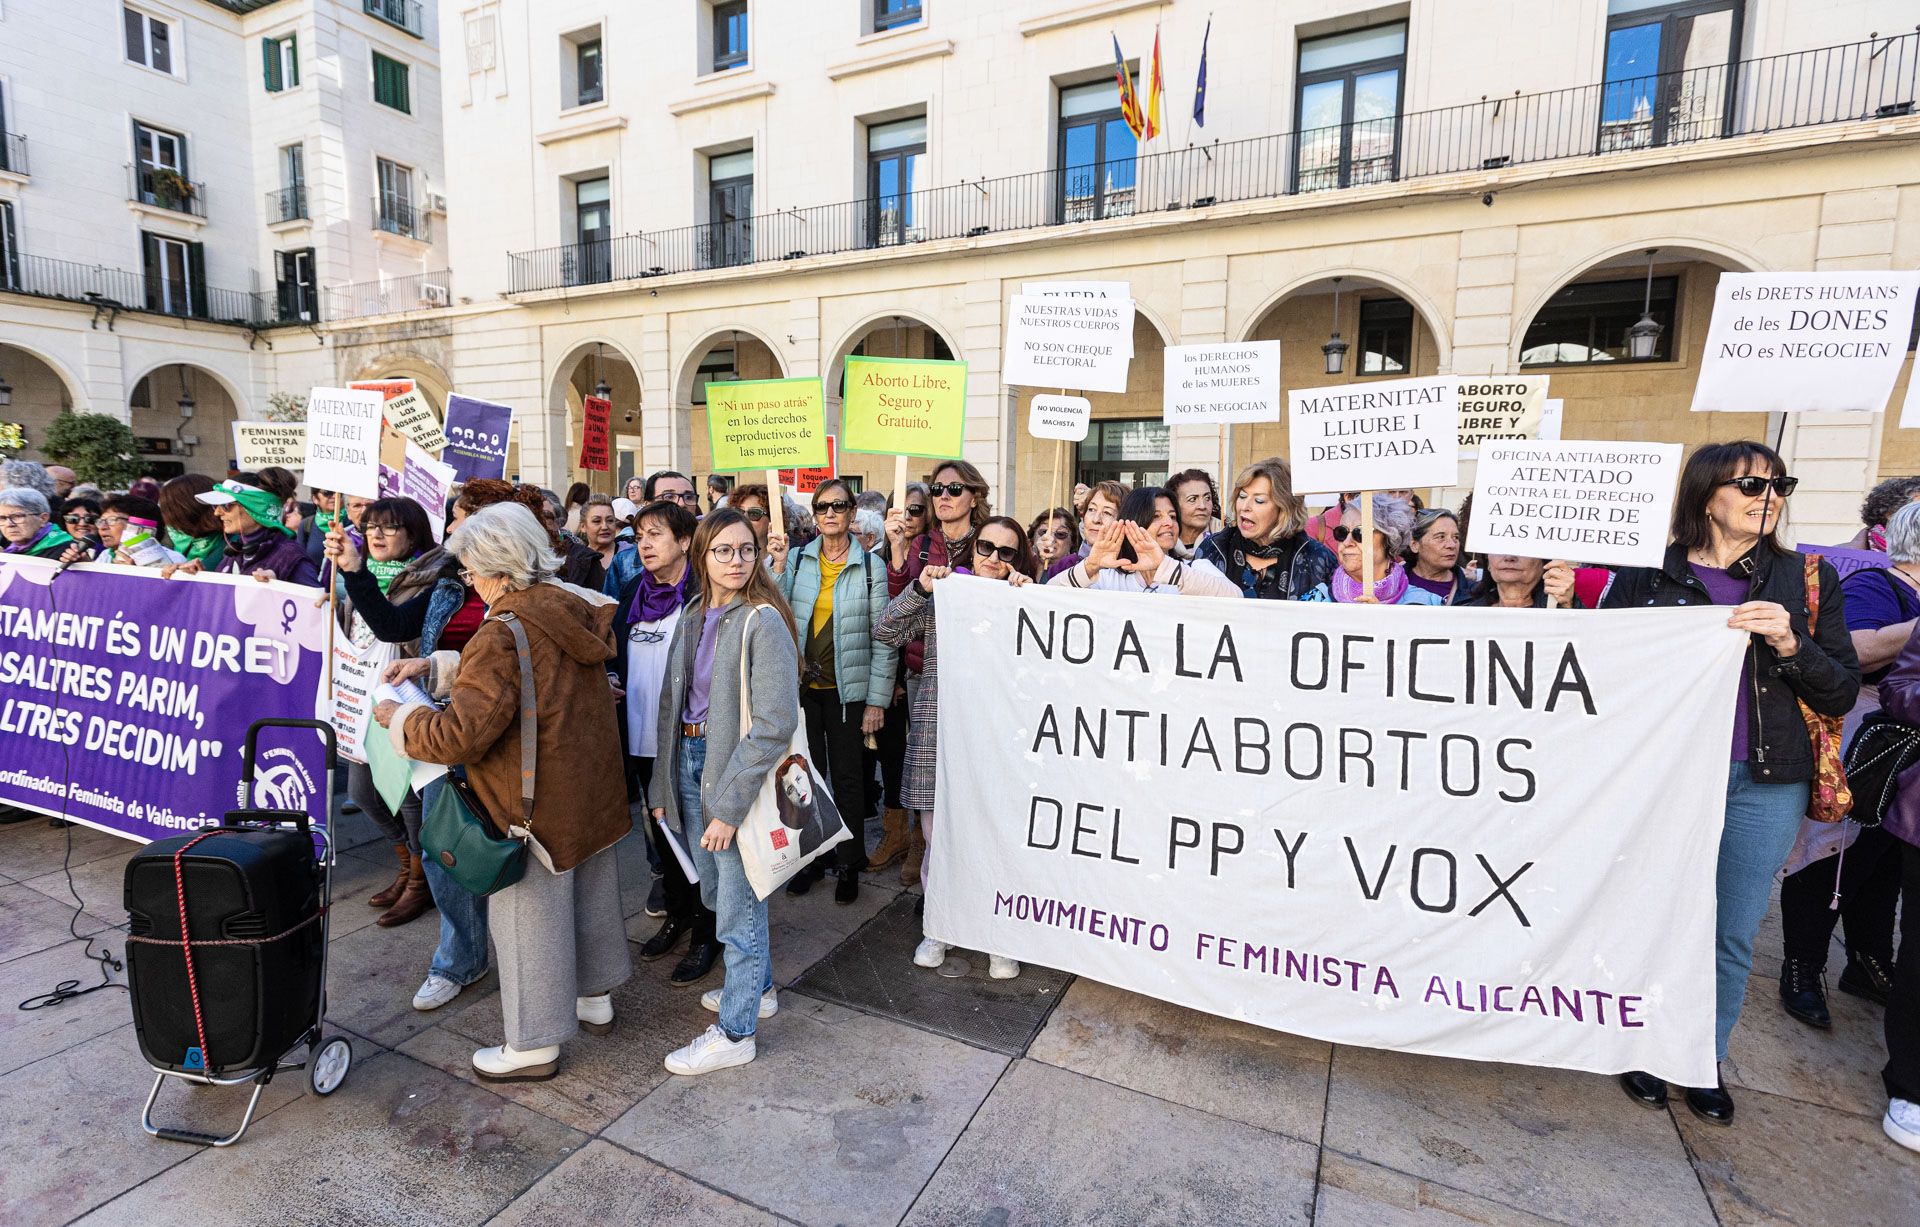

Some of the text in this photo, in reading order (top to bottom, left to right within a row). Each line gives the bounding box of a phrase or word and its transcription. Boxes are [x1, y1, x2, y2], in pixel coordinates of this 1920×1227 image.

[1731, 286, 1899, 300] els DRETS HUMANS
[1024, 304, 1118, 318] NUESTRAS VIDAS
[1020, 318, 1120, 331] NUESTROS CUERPOS
[1734, 310, 1888, 331] de les DONES
[1024, 342, 1113, 356] NO SON CHEQUE
[1184, 350, 1258, 362] los DERECHOS
[1720, 342, 1892, 358] NO es NEGOCIEN
[1034, 355, 1096, 368] ELECTORAL
[1194, 364, 1250, 375] HUMANOS
[862, 373, 950, 391] Aborto Libre,
[1182, 376, 1260, 388] de las MUJERES
[1458, 384, 1528, 396] ABORTO
[390, 396, 416, 410] FUERA
[758, 401, 780, 412] paso
[878, 394, 934, 412] Seguro y
[1176, 402, 1267, 414] NO SE NEGOCIAN
[1300, 386, 1446, 414] MATERNITAT
[312, 399, 376, 418] MATERNITAT
[400, 406, 416, 417] LOS
[1050, 406, 1083, 414] VIOLENCIA
[394, 411, 430, 430] ROSARIOS
[728, 413, 807, 426] en los derechos
[878, 413, 932, 430] Gratuito.
[1042, 419, 1075, 427] MACHISTA
[1324, 414, 1421, 436] LLIURE I
[1510, 417, 1520, 428] Y
[241, 428, 305, 436] FEMINISME
[412, 424, 423, 433] DE
[413, 428, 441, 443] ESTROS
[726, 428, 812, 444] reproductivos de
[313, 444, 367, 466] DESITJADA
[740, 445, 800, 458] las mujeres.
[1310, 438, 1436, 461] DESITJADA
[1491, 450, 1662, 465] OFICINA ANTIABORTO
[1511, 467, 1633, 485] ATENTADO
[1487, 486, 1654, 504] CONTRA EL DERECHO
[1488, 502, 1640, 524] A DECIDIR DE
[1488, 523, 1640, 547] LAS MUJERES
[0, 604, 289, 678] TAMENT ÉS UN DRET
[1016, 607, 1598, 716] NO A LA OFICINA
[0, 651, 204, 730] SALTRES PARIM,
[0, 699, 83, 746] LTRES
[1032, 704, 1536, 803] ANTIABORTOS
[0, 770, 220, 831] ordinadora Feminista de València
[1027, 796, 1534, 928] DEL PP Y VOX
[994, 890, 1644, 1028] MOVIMIENTO FEMINISTA ALICANTE
